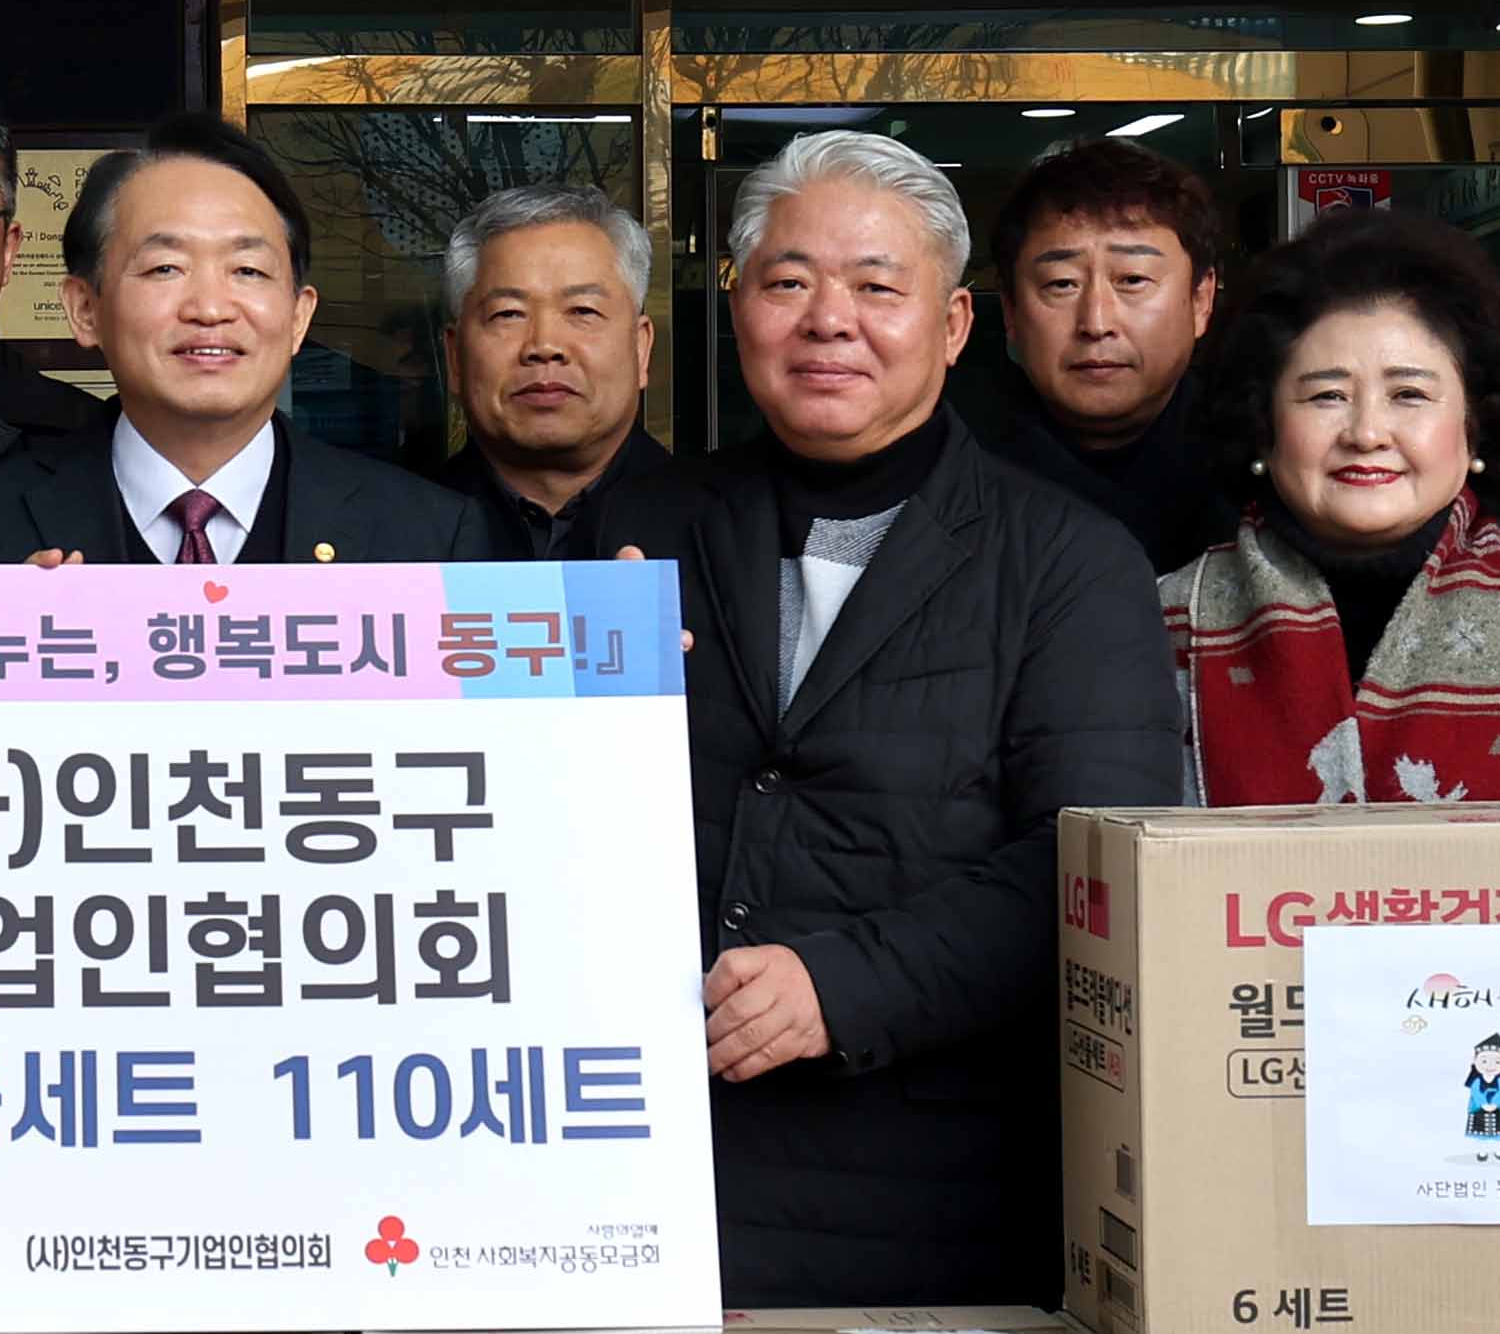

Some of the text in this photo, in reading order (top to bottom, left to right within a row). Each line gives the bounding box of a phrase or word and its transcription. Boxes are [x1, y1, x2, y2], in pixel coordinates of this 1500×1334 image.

[1308, 172, 1343, 185] CCTV
[34, 300, 65, 311] unice
[147, 612, 406, 680] 행복도시
[273, 1046, 651, 1144] 110세트
[1416, 1178, 1487, 1199] 사단법인
[26, 1234, 332, 1272] (사)인천동구기업인협의회
[430, 1244, 661, 1273] 인천 사회복지공동모금회
[1233, 1288, 1354, 1329] 6 세트
